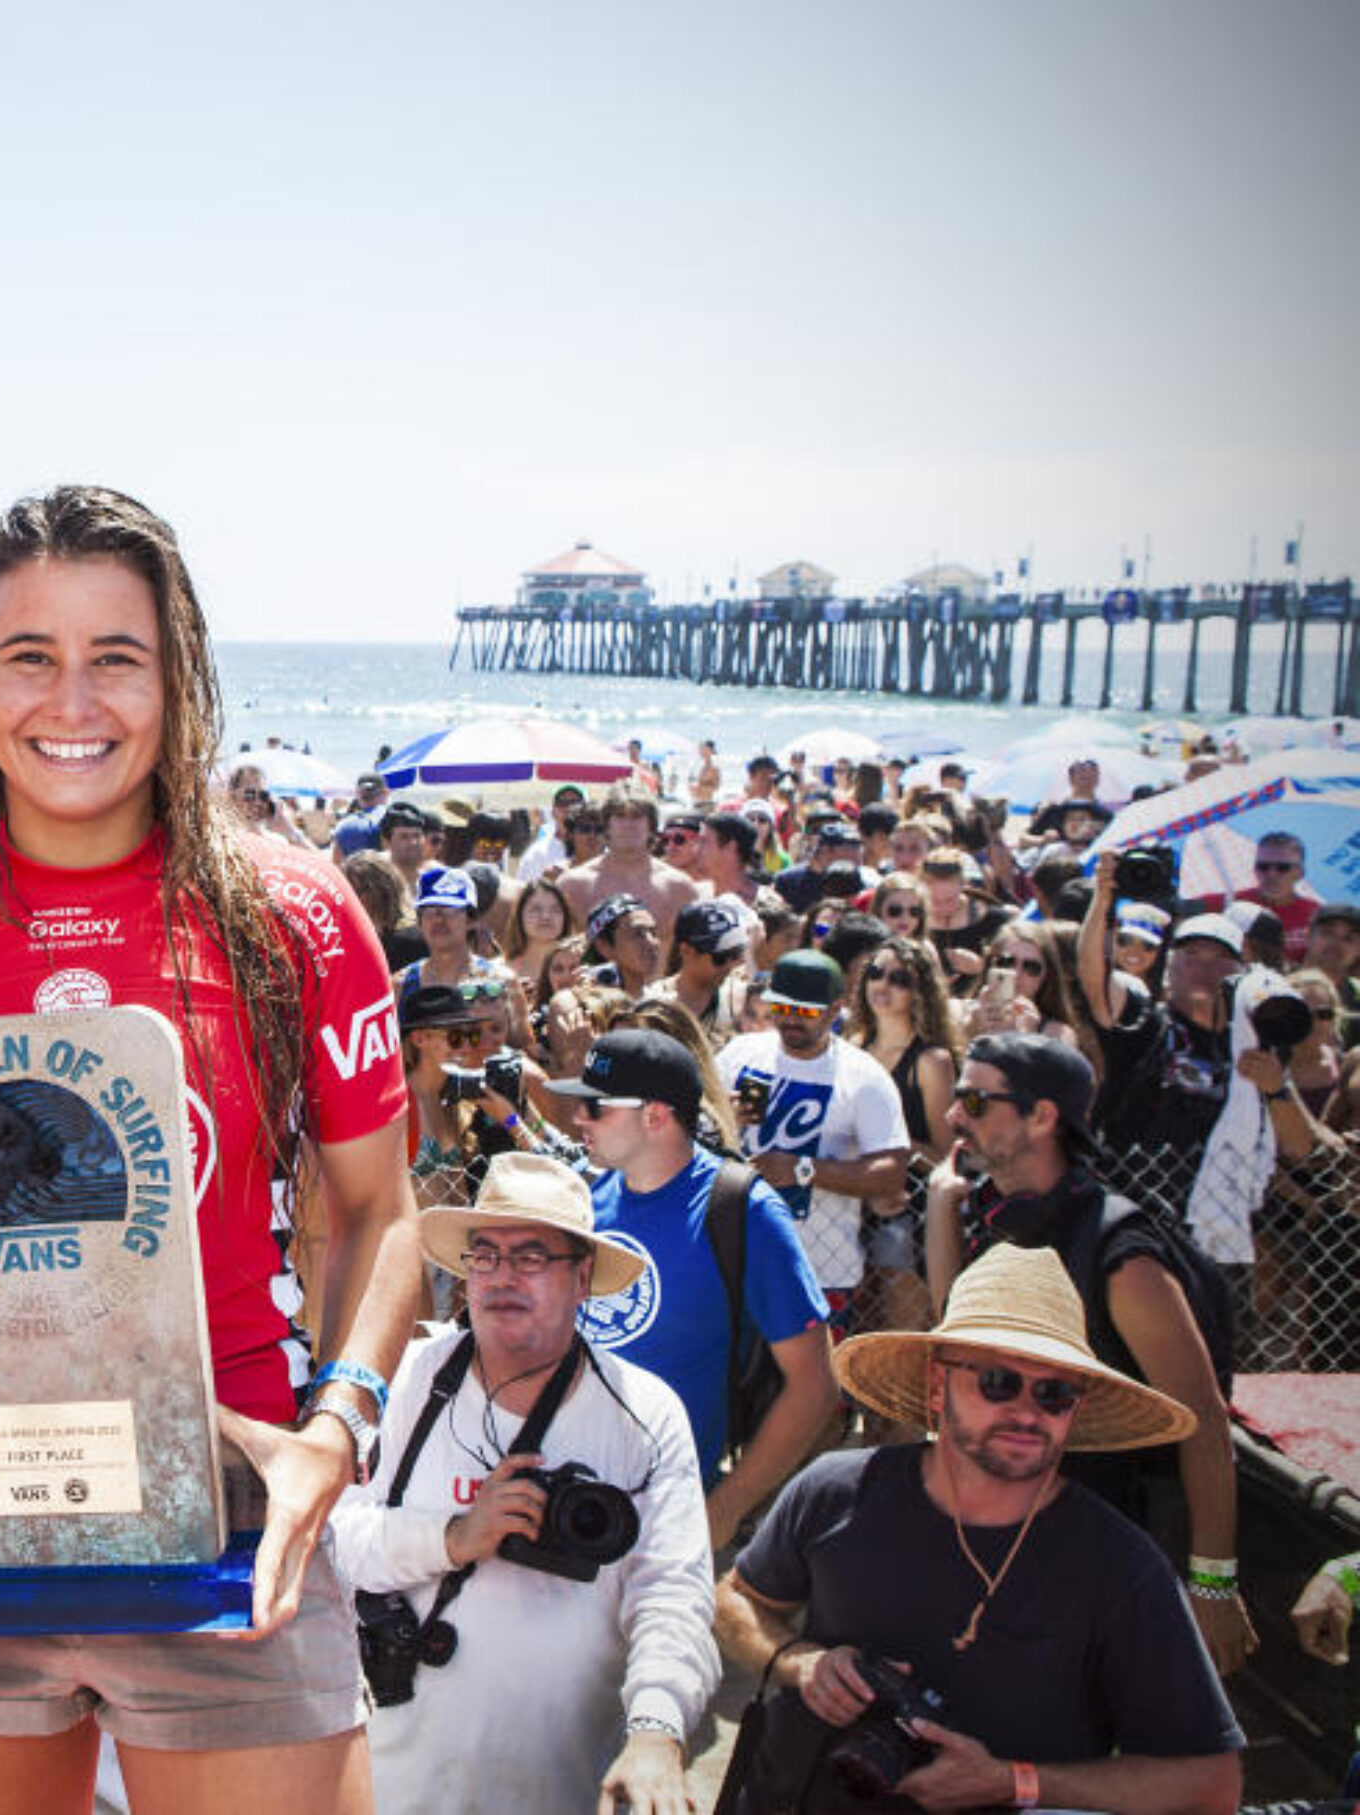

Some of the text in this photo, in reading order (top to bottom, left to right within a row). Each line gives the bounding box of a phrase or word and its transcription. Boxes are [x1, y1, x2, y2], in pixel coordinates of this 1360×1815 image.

[28, 918, 122, 940] Galaxy
[46, 1038, 104, 1083] OF
[99, 1075, 172, 1258] SURFING
[8, 1448, 85, 1463] FIRST PLACE
[10, 1484, 51, 1502] VANS
